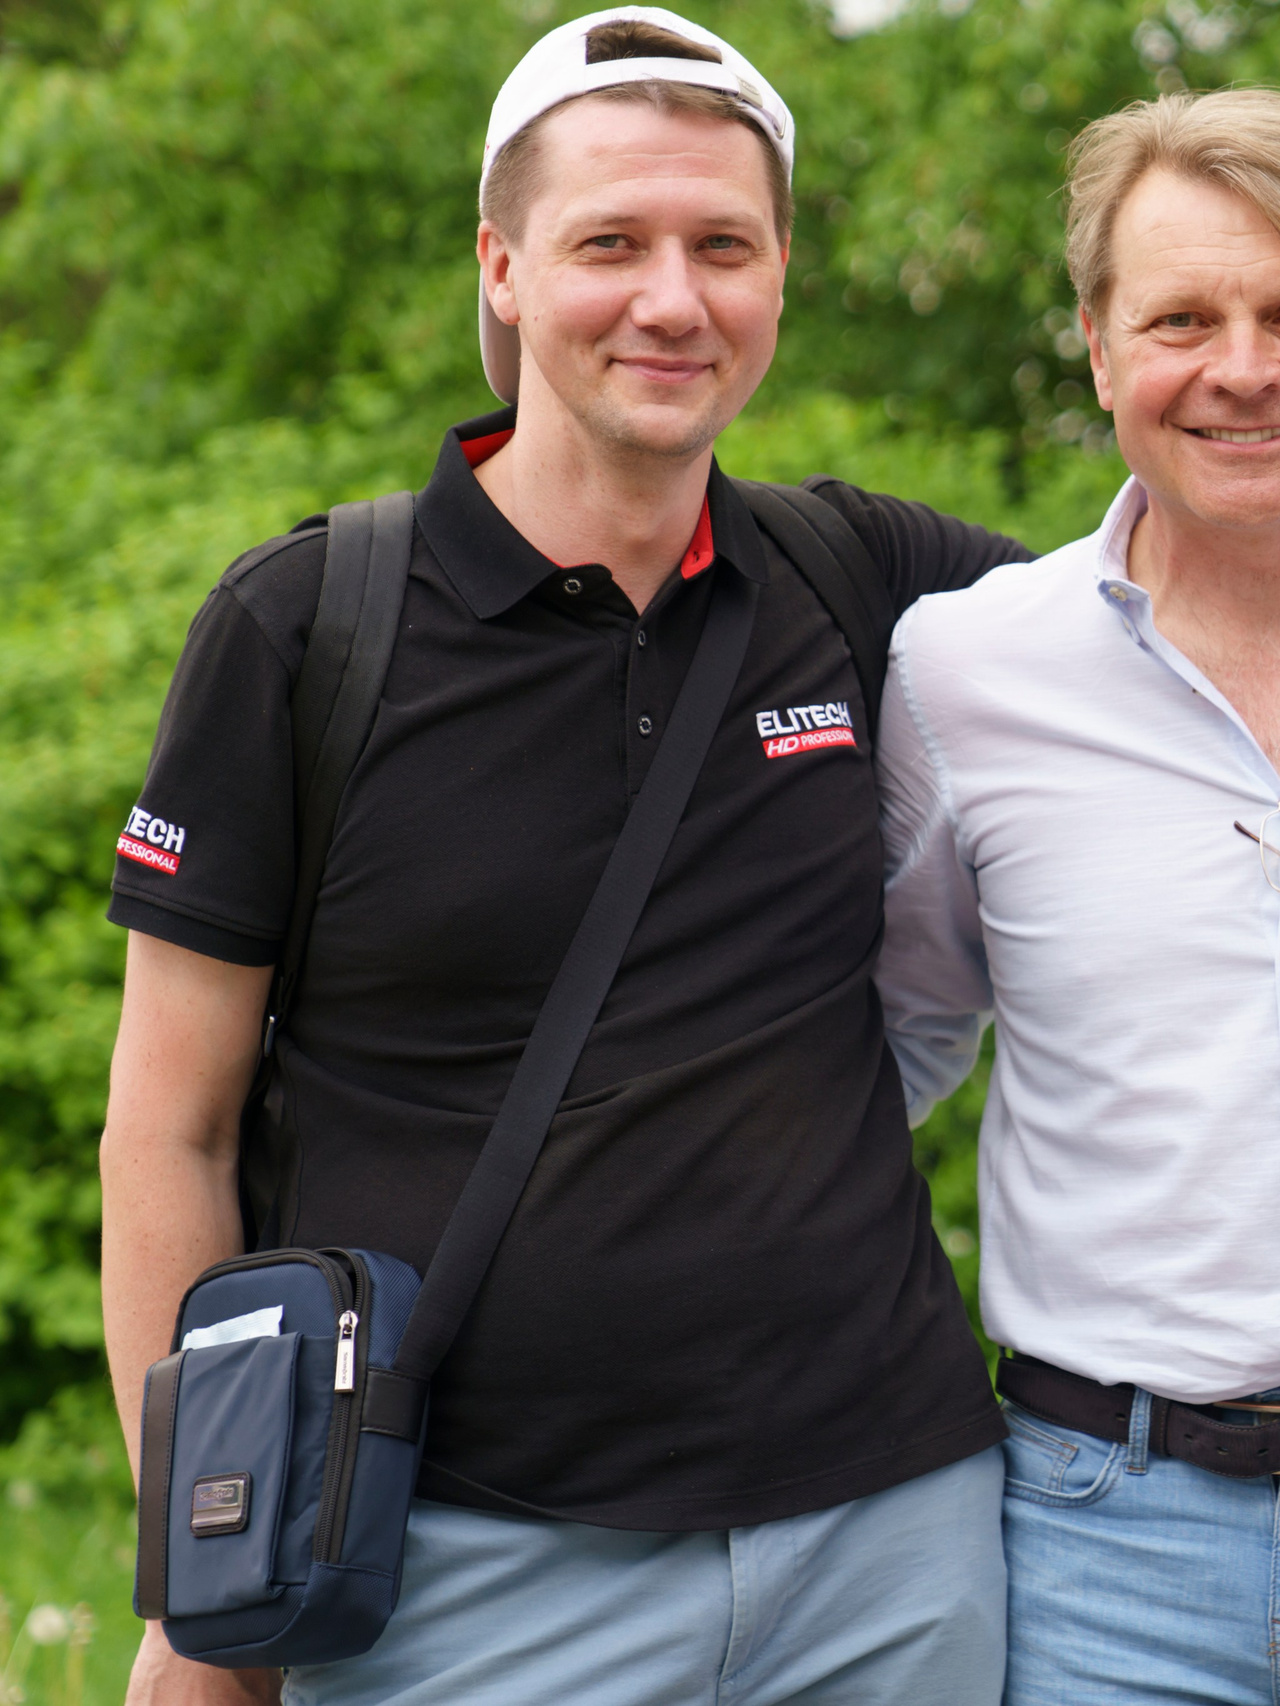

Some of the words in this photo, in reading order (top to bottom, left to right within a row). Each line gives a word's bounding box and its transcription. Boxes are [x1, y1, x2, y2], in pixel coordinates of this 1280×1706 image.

[756, 702, 853, 738] ELITECH
[767, 736, 799, 756] HD
[117, 837, 177, 871] FESSIONAL
